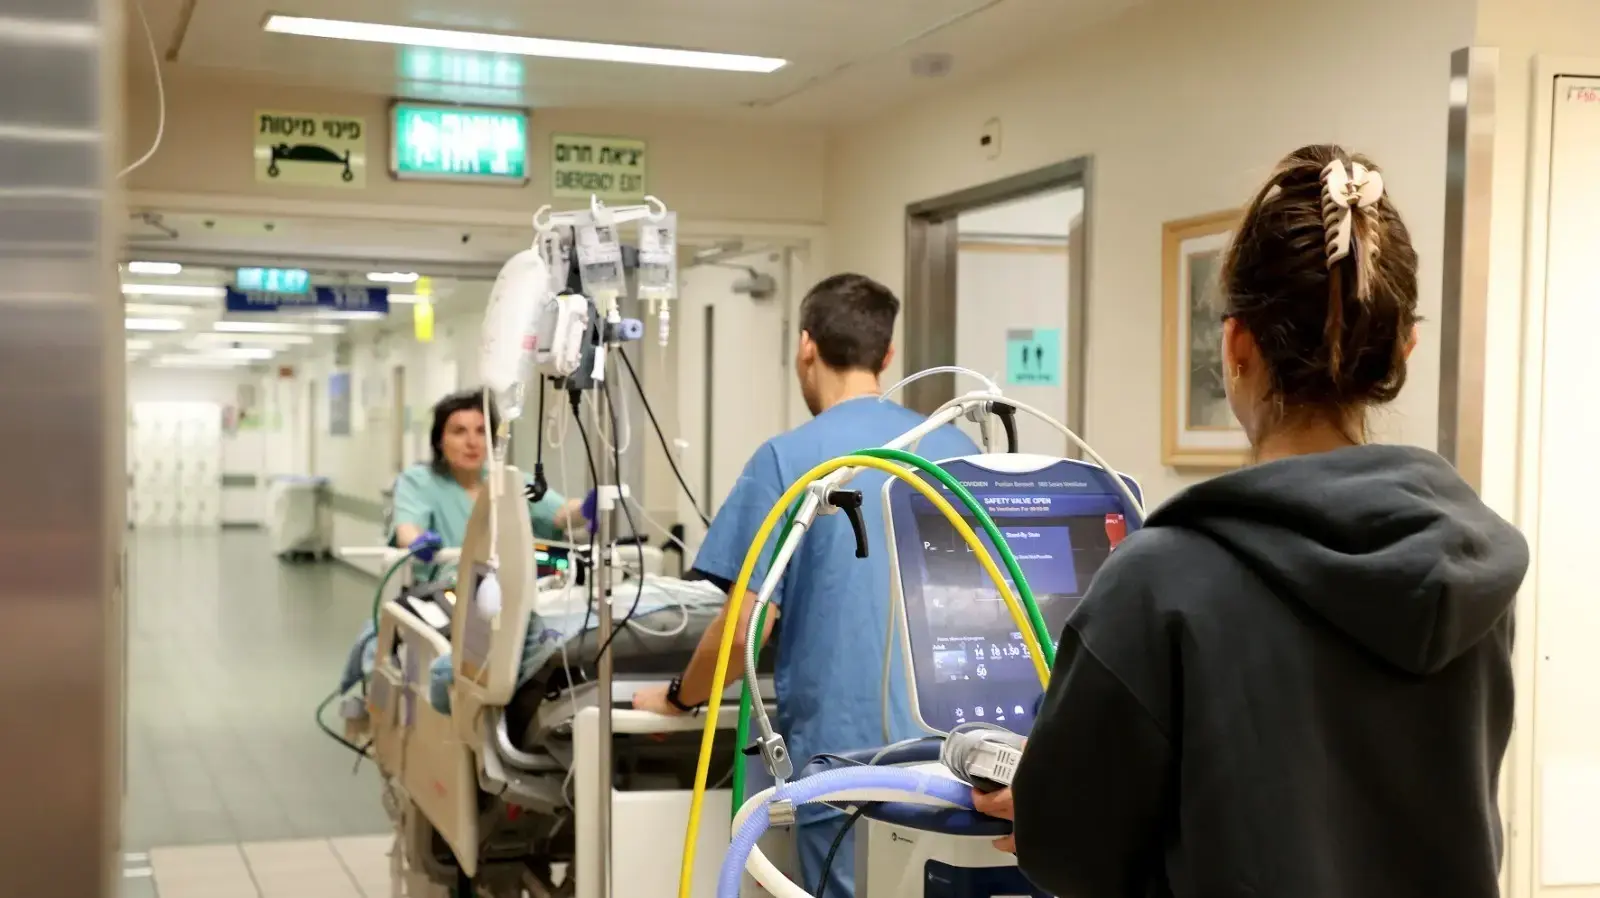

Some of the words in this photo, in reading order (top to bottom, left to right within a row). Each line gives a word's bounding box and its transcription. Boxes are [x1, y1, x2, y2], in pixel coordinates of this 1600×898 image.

[259, 114, 316, 137] מיטות
[322, 120, 361, 140] פינוי
[555, 143, 593, 164] חרום
[555, 169, 614, 190] EMERGENCY
[620, 173, 643, 193] EXIT
[984, 497, 1011, 505] SAFETY
[1011, 497, 1033, 505] VALVE
[1033, 497, 1052, 505] OPEN
[974, 648, 984, 657] 14
[1002, 647, 1020, 657] 1.50
[976, 667, 987, 676] 50
